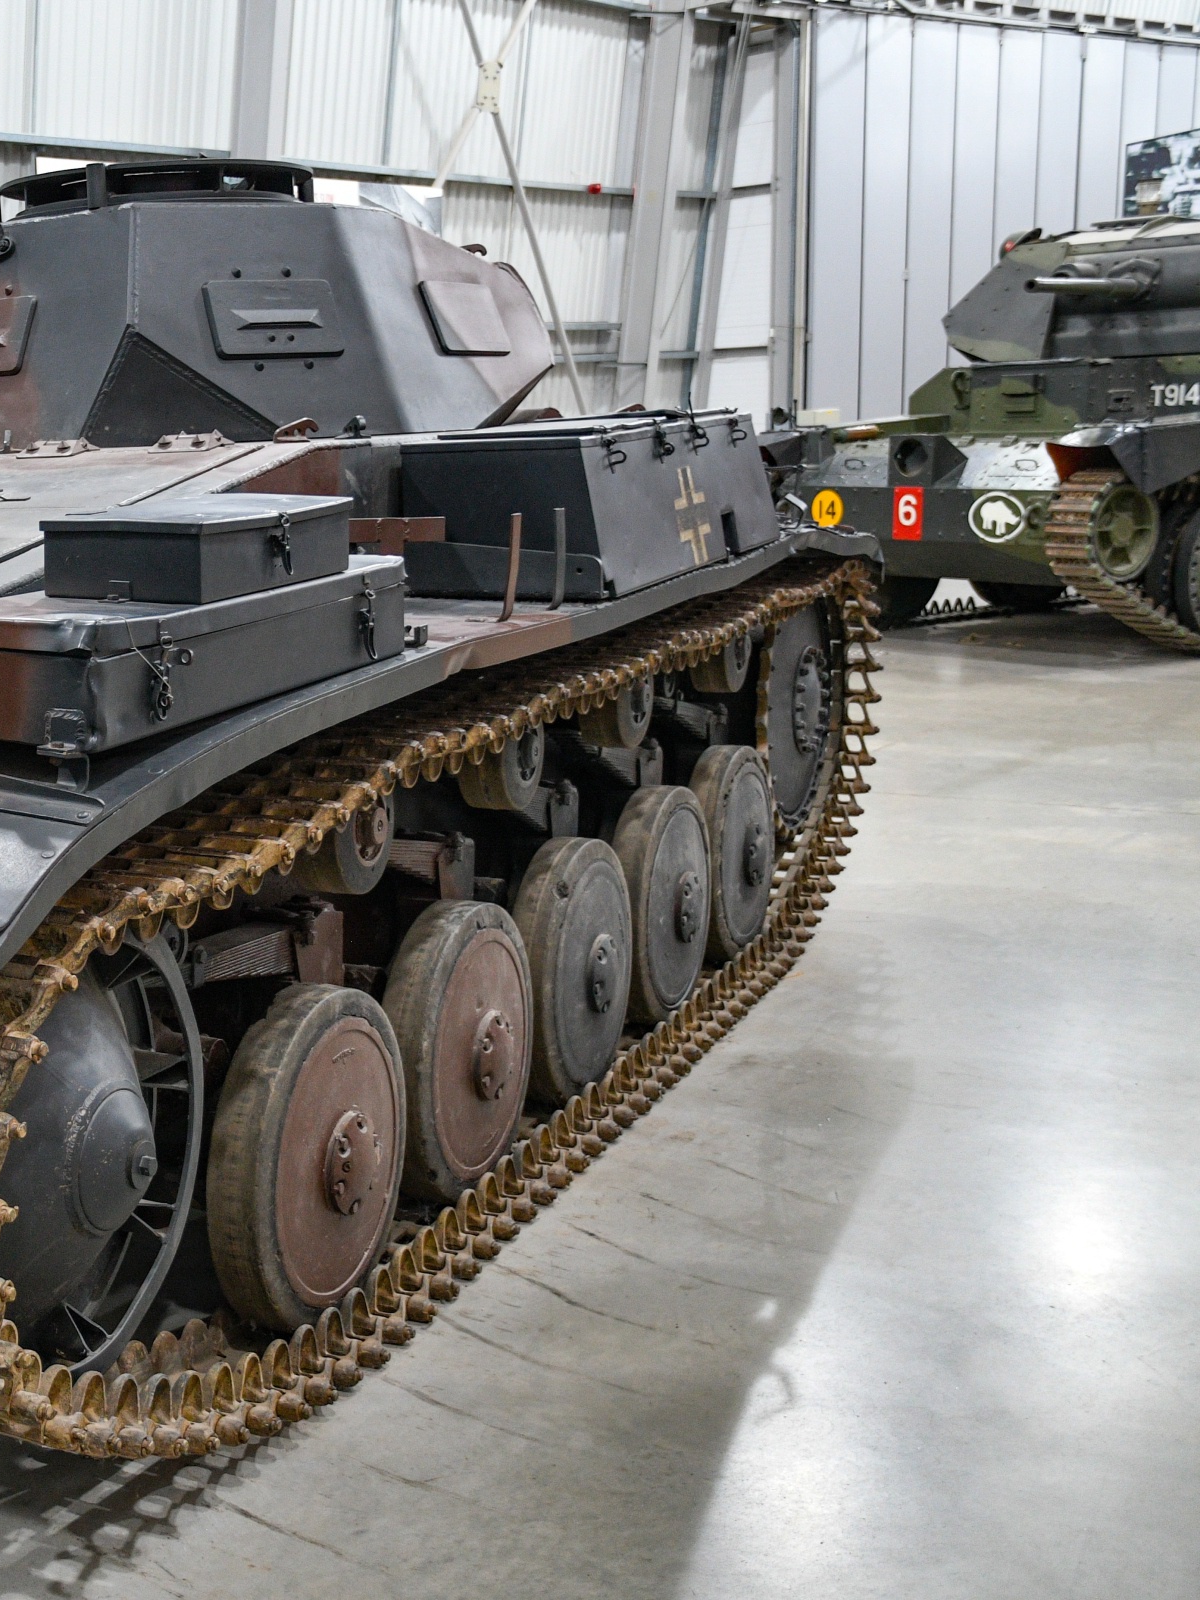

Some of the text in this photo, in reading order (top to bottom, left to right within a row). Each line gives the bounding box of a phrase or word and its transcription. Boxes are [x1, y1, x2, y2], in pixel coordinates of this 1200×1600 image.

[1150, 382, 1200, 407] T914
[818, 500, 836, 519] 14
[898, 494, 918, 527] 6
